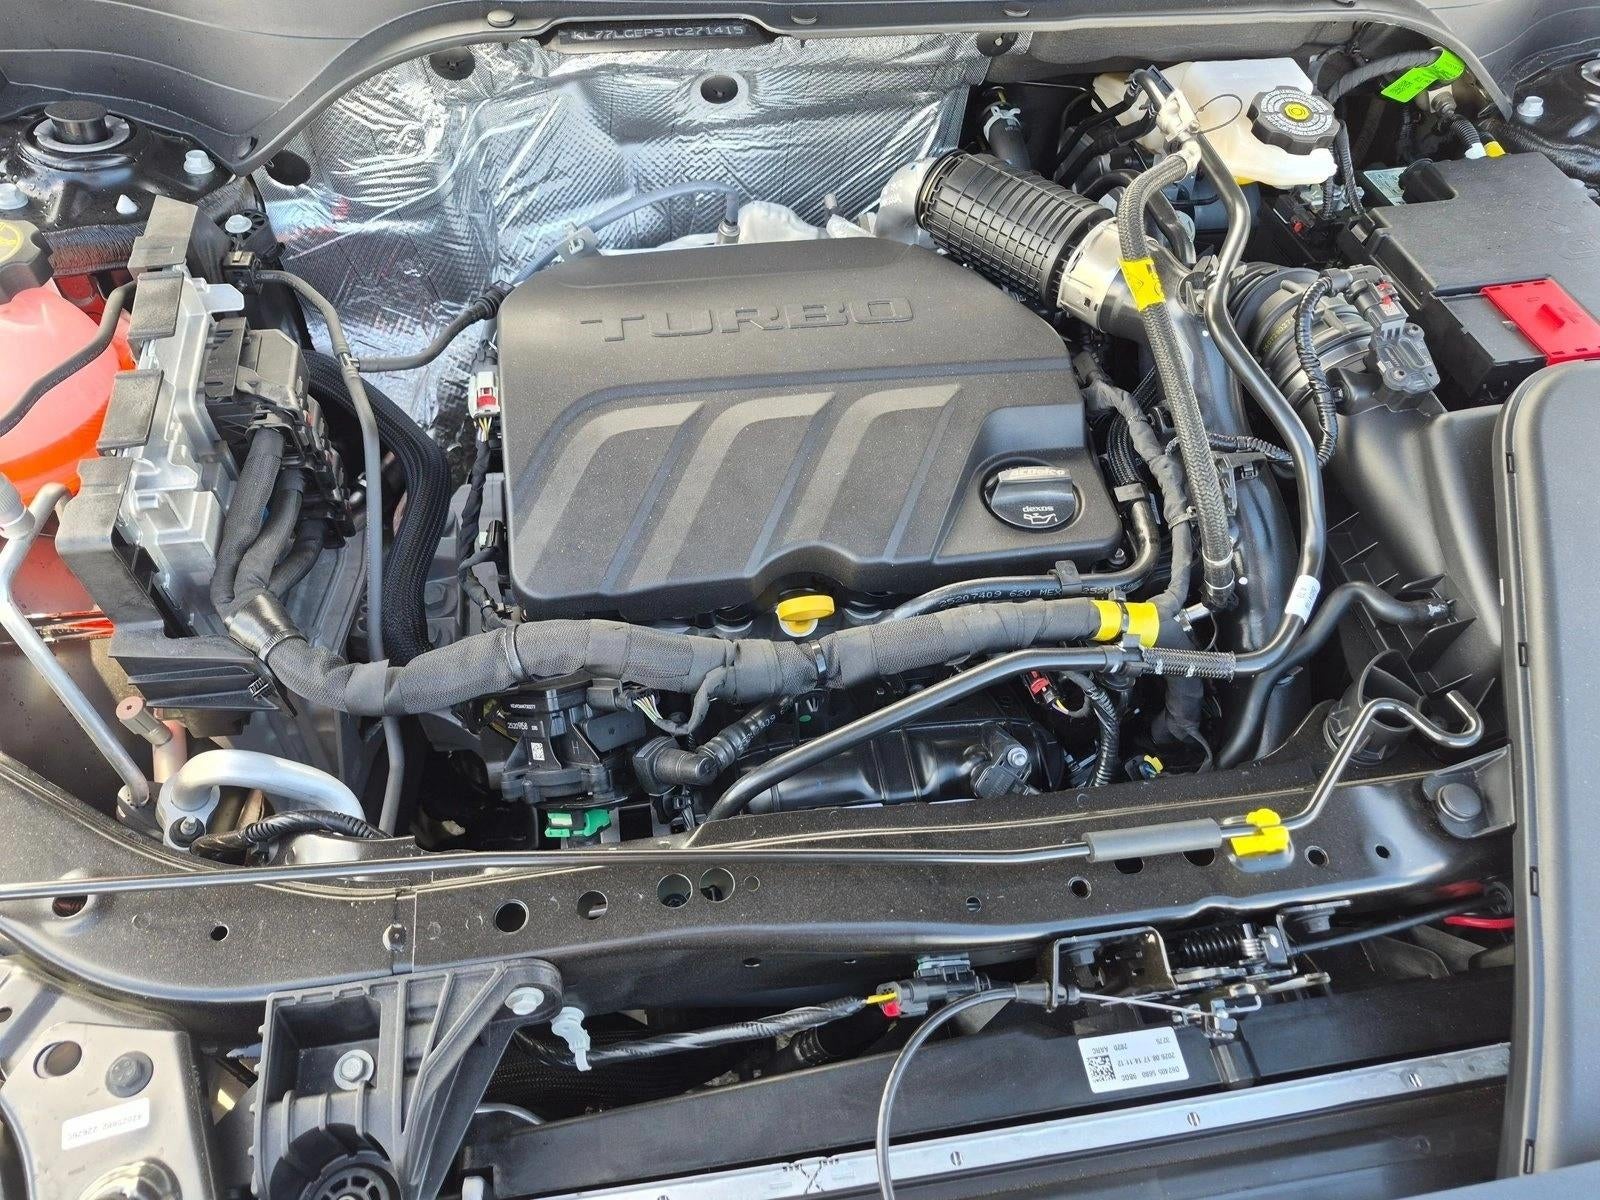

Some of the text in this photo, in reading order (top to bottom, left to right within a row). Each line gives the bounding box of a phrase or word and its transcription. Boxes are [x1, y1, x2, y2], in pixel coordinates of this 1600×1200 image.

[571, 25, 744, 41] KL77LGEP5TC271415
[579, 299, 914, 342] TURBO
[1022, 504, 1055, 513] dexos
[1039, 587, 1062, 597] MEX
